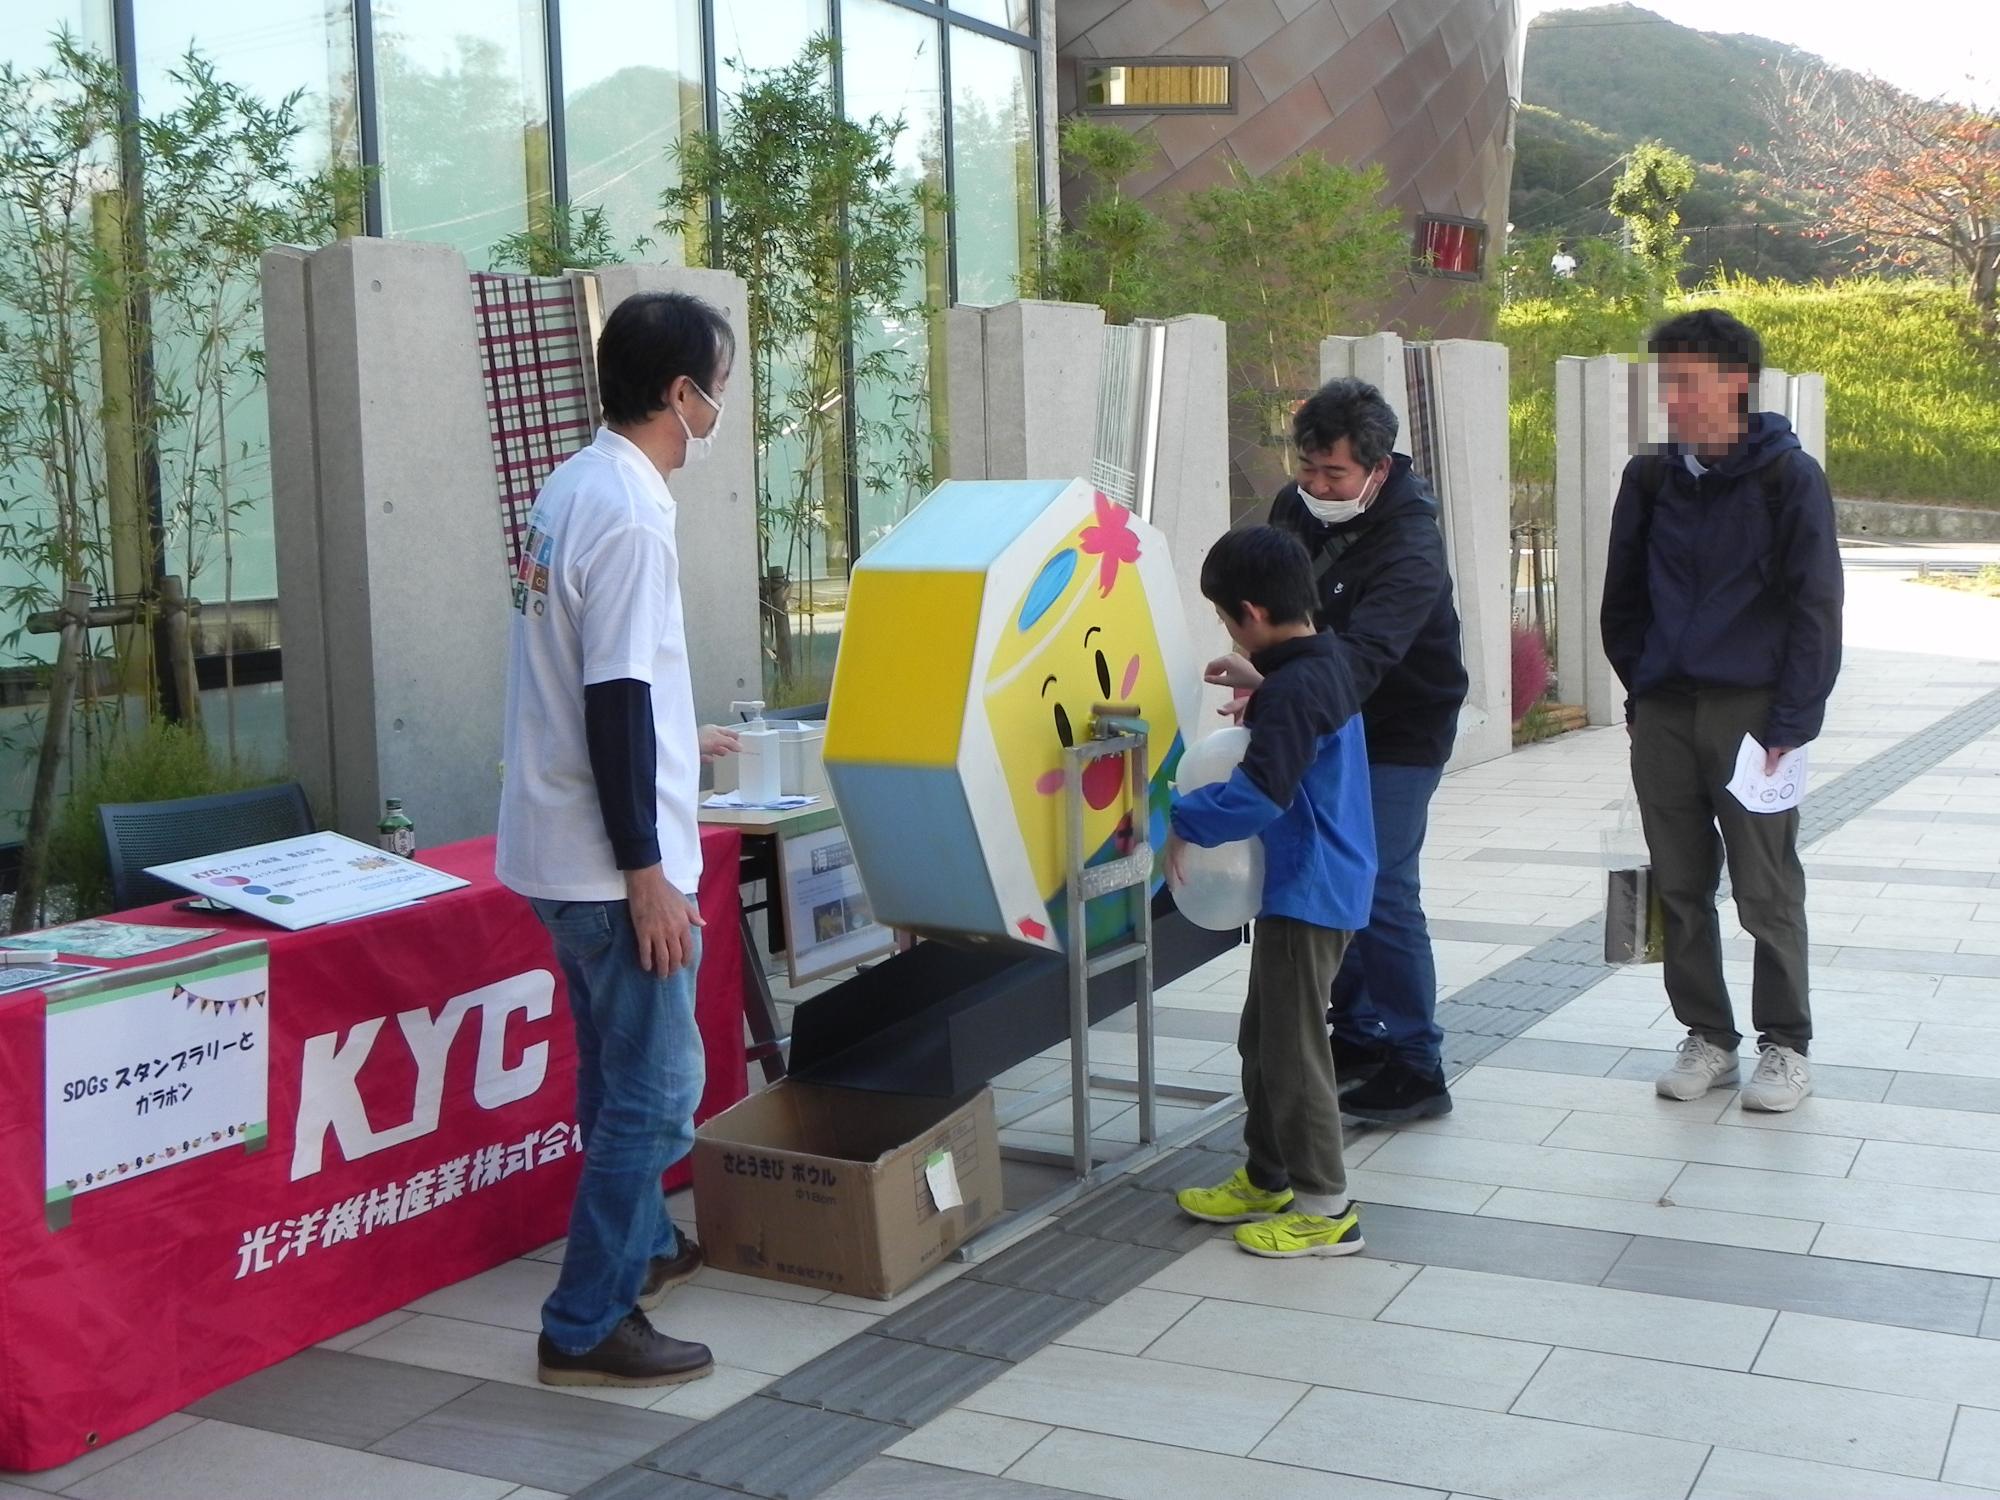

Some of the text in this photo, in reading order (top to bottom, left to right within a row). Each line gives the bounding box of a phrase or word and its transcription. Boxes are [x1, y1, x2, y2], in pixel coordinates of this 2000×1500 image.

[63, 1031, 255, 1103] SDGs スタンプラリーと
[291, 968, 556, 1182] KYC
[723, 1152, 784, 1181] さとうきび
